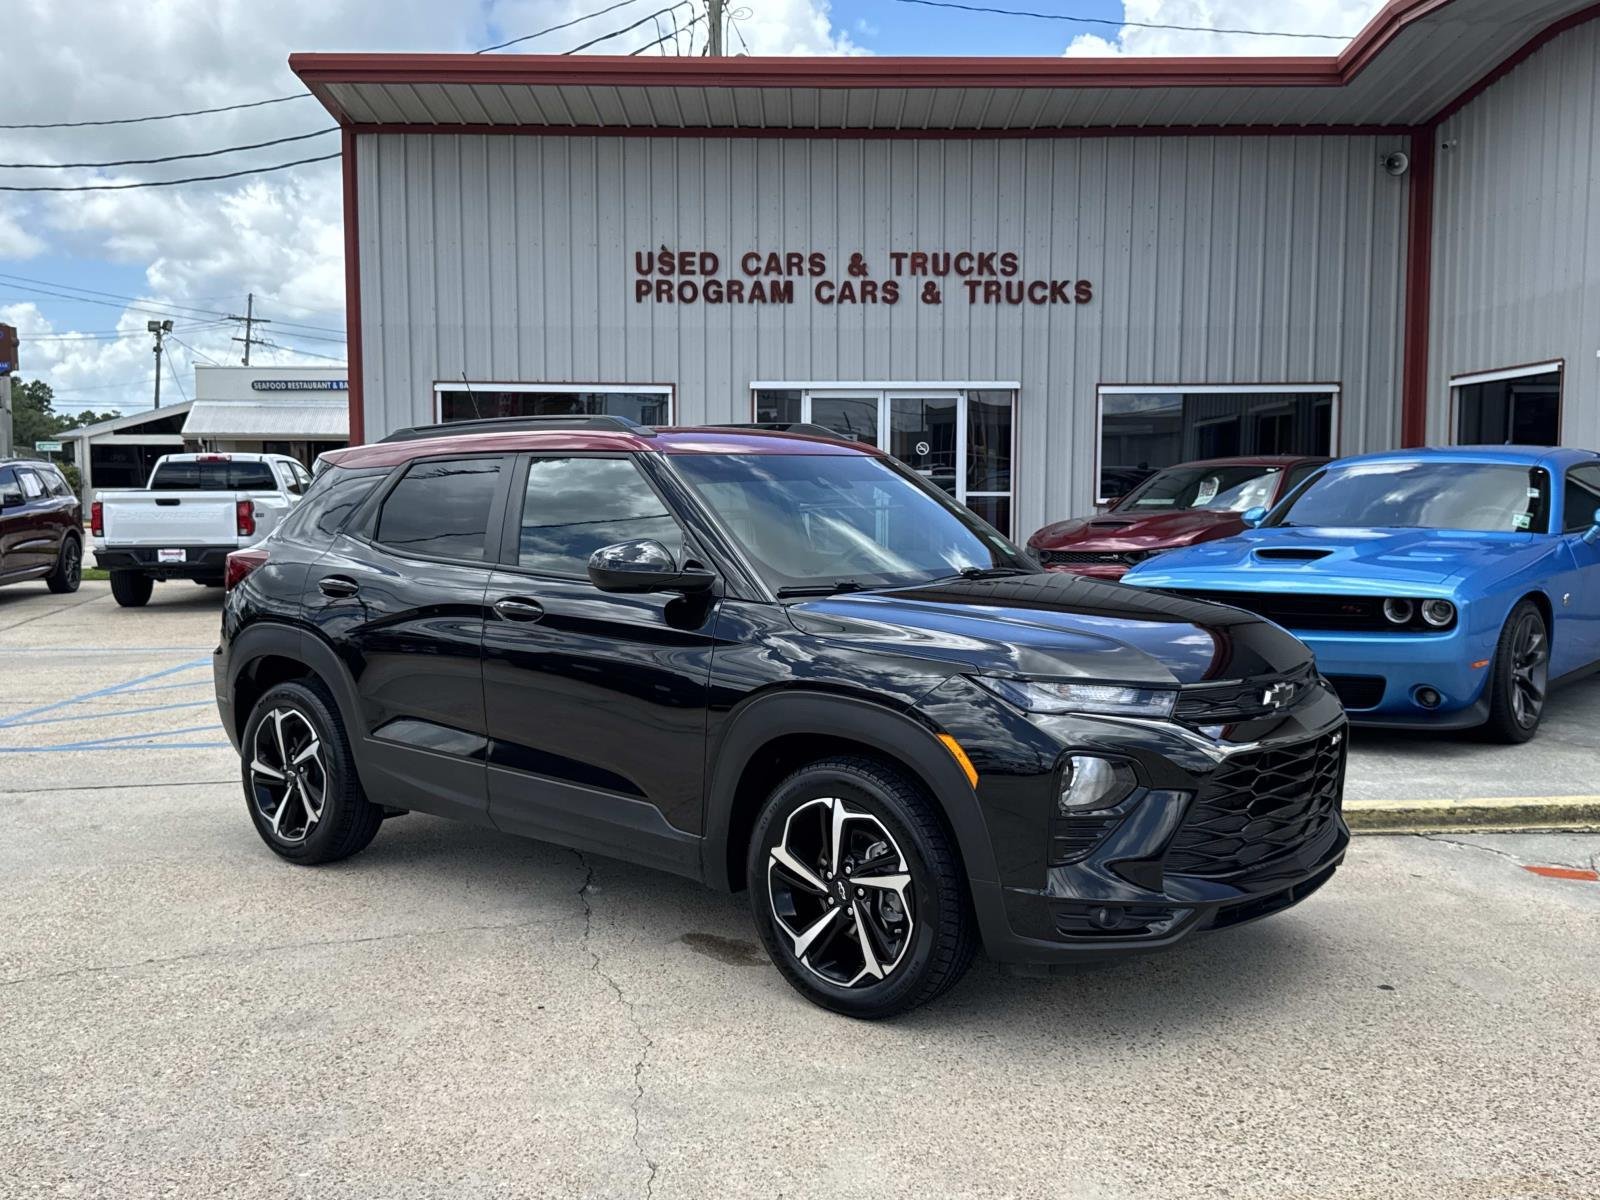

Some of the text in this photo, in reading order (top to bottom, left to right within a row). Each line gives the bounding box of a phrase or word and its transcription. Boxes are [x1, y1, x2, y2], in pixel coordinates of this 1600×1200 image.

[635, 251, 1019, 276] USED CARS & TRUCKS
[635, 279, 1093, 304] PROGRAM CARS & TRUCKS
[254, 382, 286, 390] SEAFOOD
[288, 382, 331, 390] RESTAURANT
[332, 382, 338, 390] &
